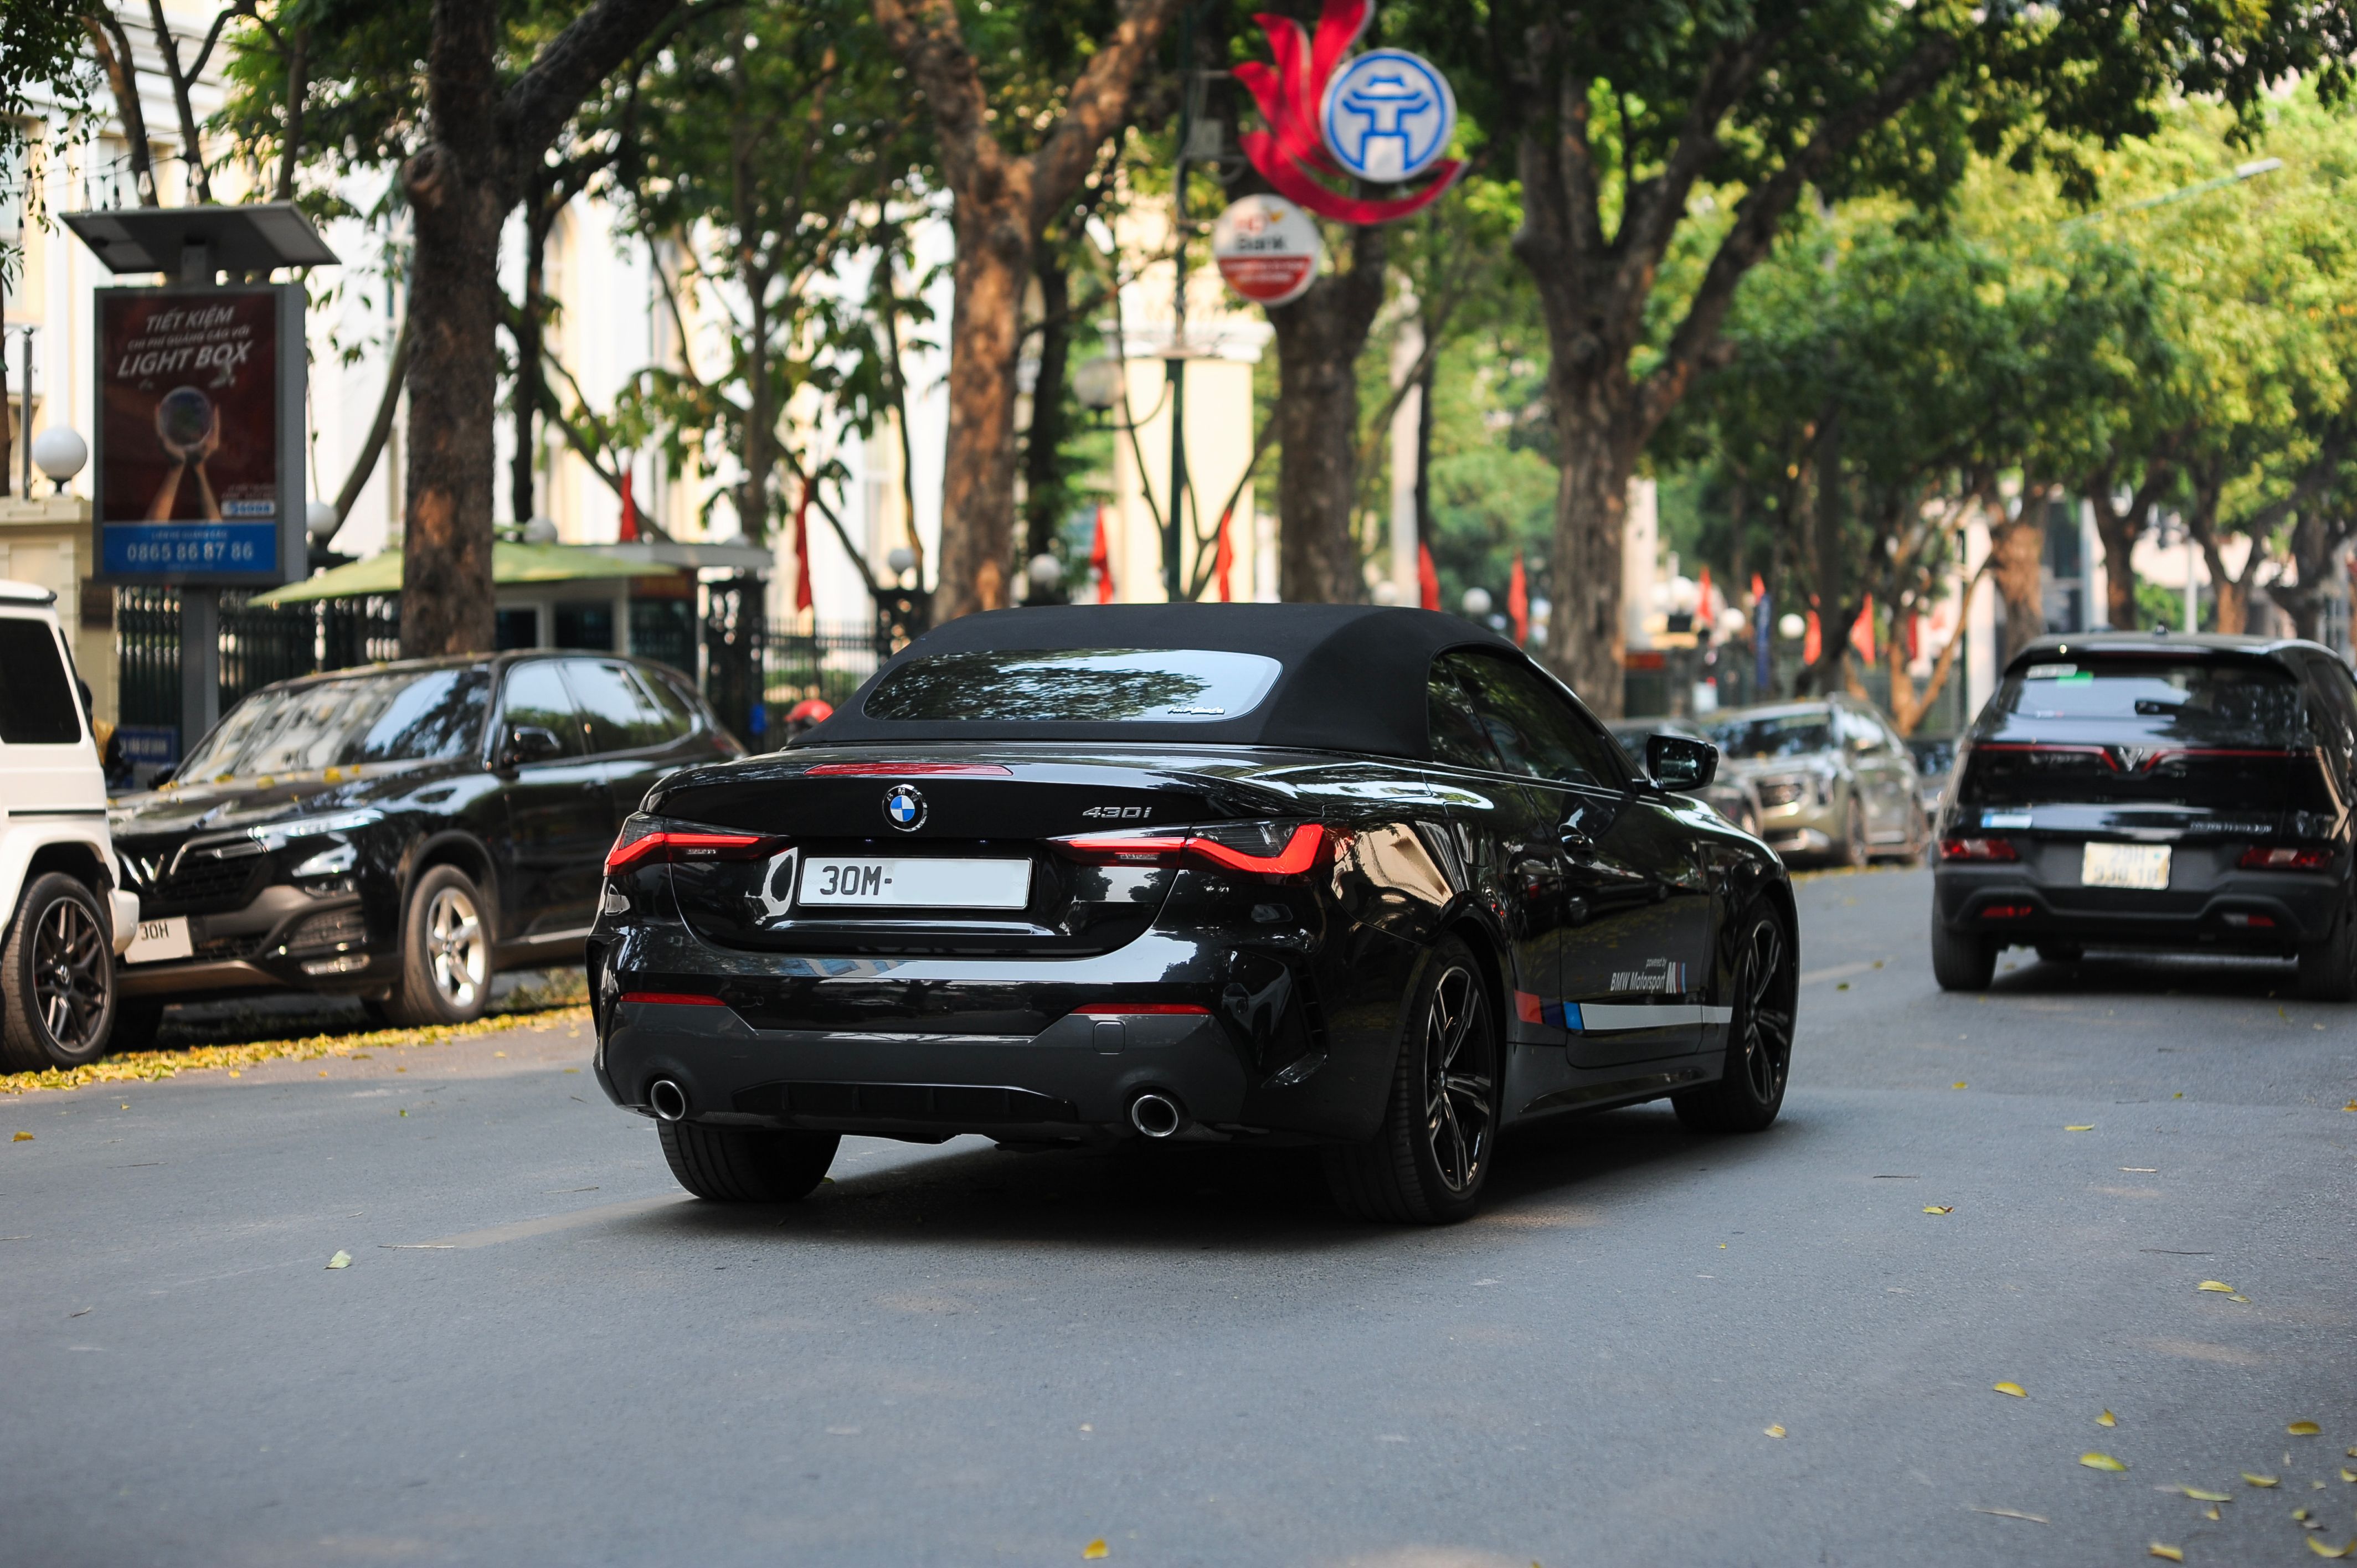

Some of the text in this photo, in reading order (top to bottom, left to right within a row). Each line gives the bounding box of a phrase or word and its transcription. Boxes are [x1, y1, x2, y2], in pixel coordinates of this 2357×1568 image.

[146, 304, 235, 333] TIẾT KIỆM
[117, 340, 253, 378] LIGHT BOX
[127, 541, 254, 562] 0865 86 87 86
[1083, 807, 1152, 818] 430i
[1610, 972, 1666, 994] BMW Motorsport
